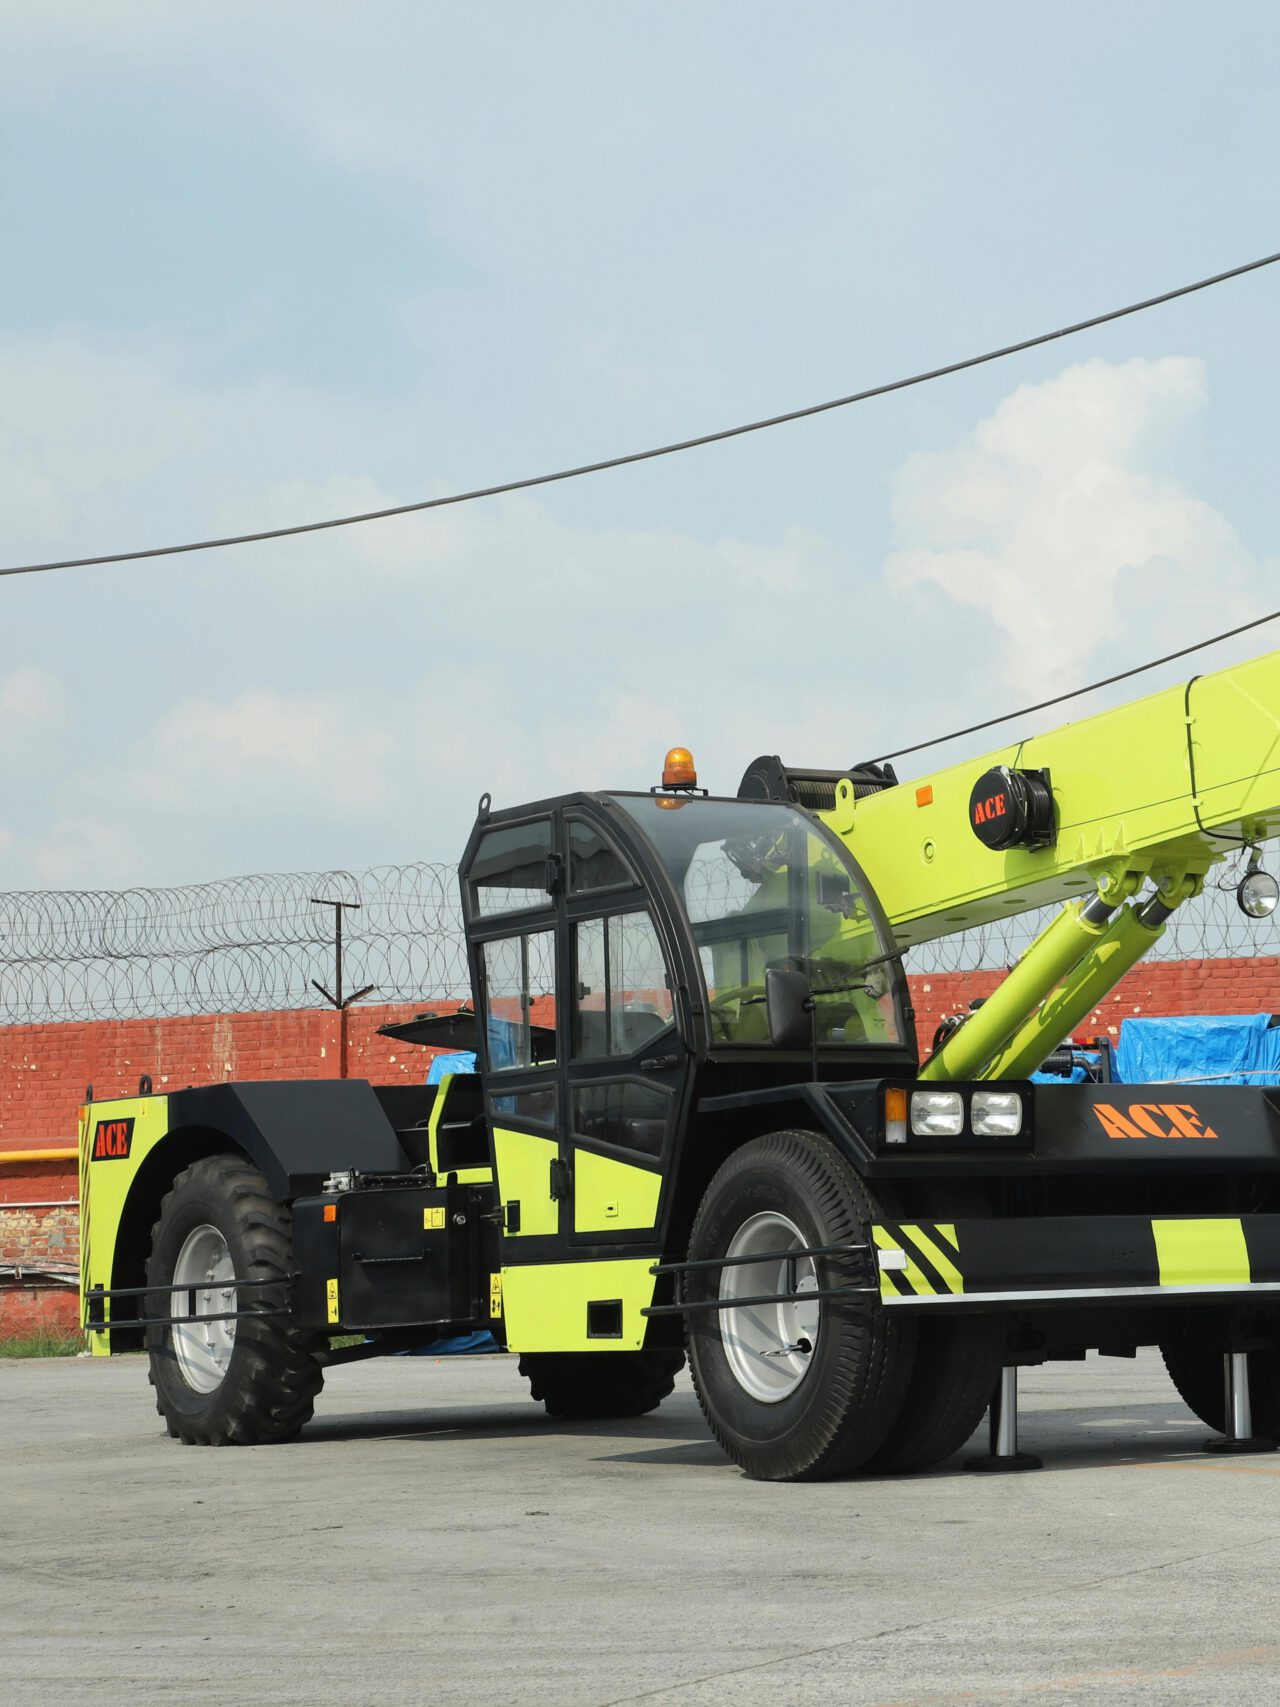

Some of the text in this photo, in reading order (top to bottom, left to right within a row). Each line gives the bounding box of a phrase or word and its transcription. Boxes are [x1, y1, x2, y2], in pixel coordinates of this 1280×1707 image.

[974, 793, 1006, 825] ACE
[1092, 1103, 1219, 1139] ACE
[95, 1122, 128, 1157] ACE
